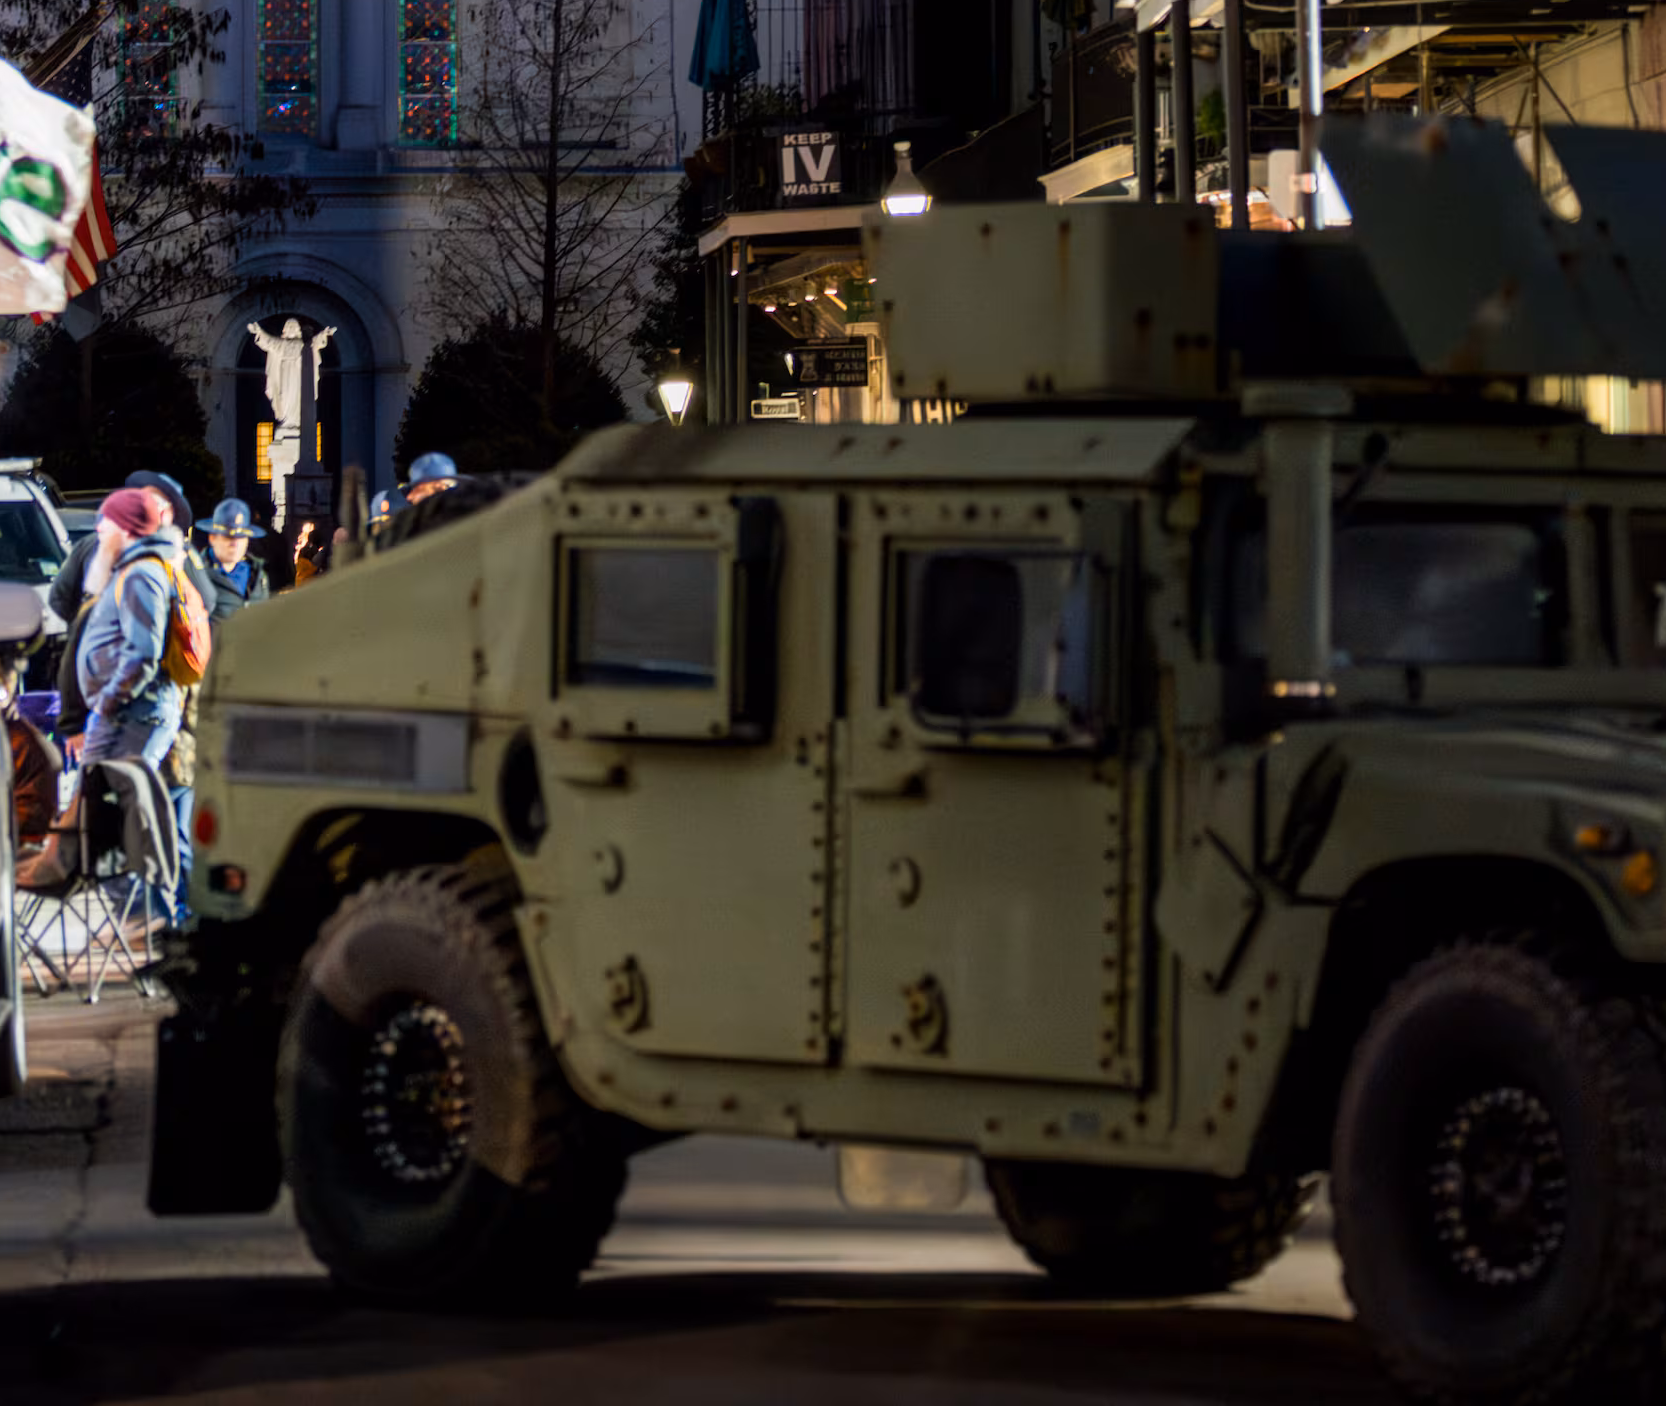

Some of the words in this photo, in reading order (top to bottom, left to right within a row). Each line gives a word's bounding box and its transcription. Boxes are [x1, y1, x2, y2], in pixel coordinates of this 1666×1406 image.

[783, 132, 832, 146] KEEP
[781, 144, 836, 184] IV
[782, 182, 841, 196] WASTE
